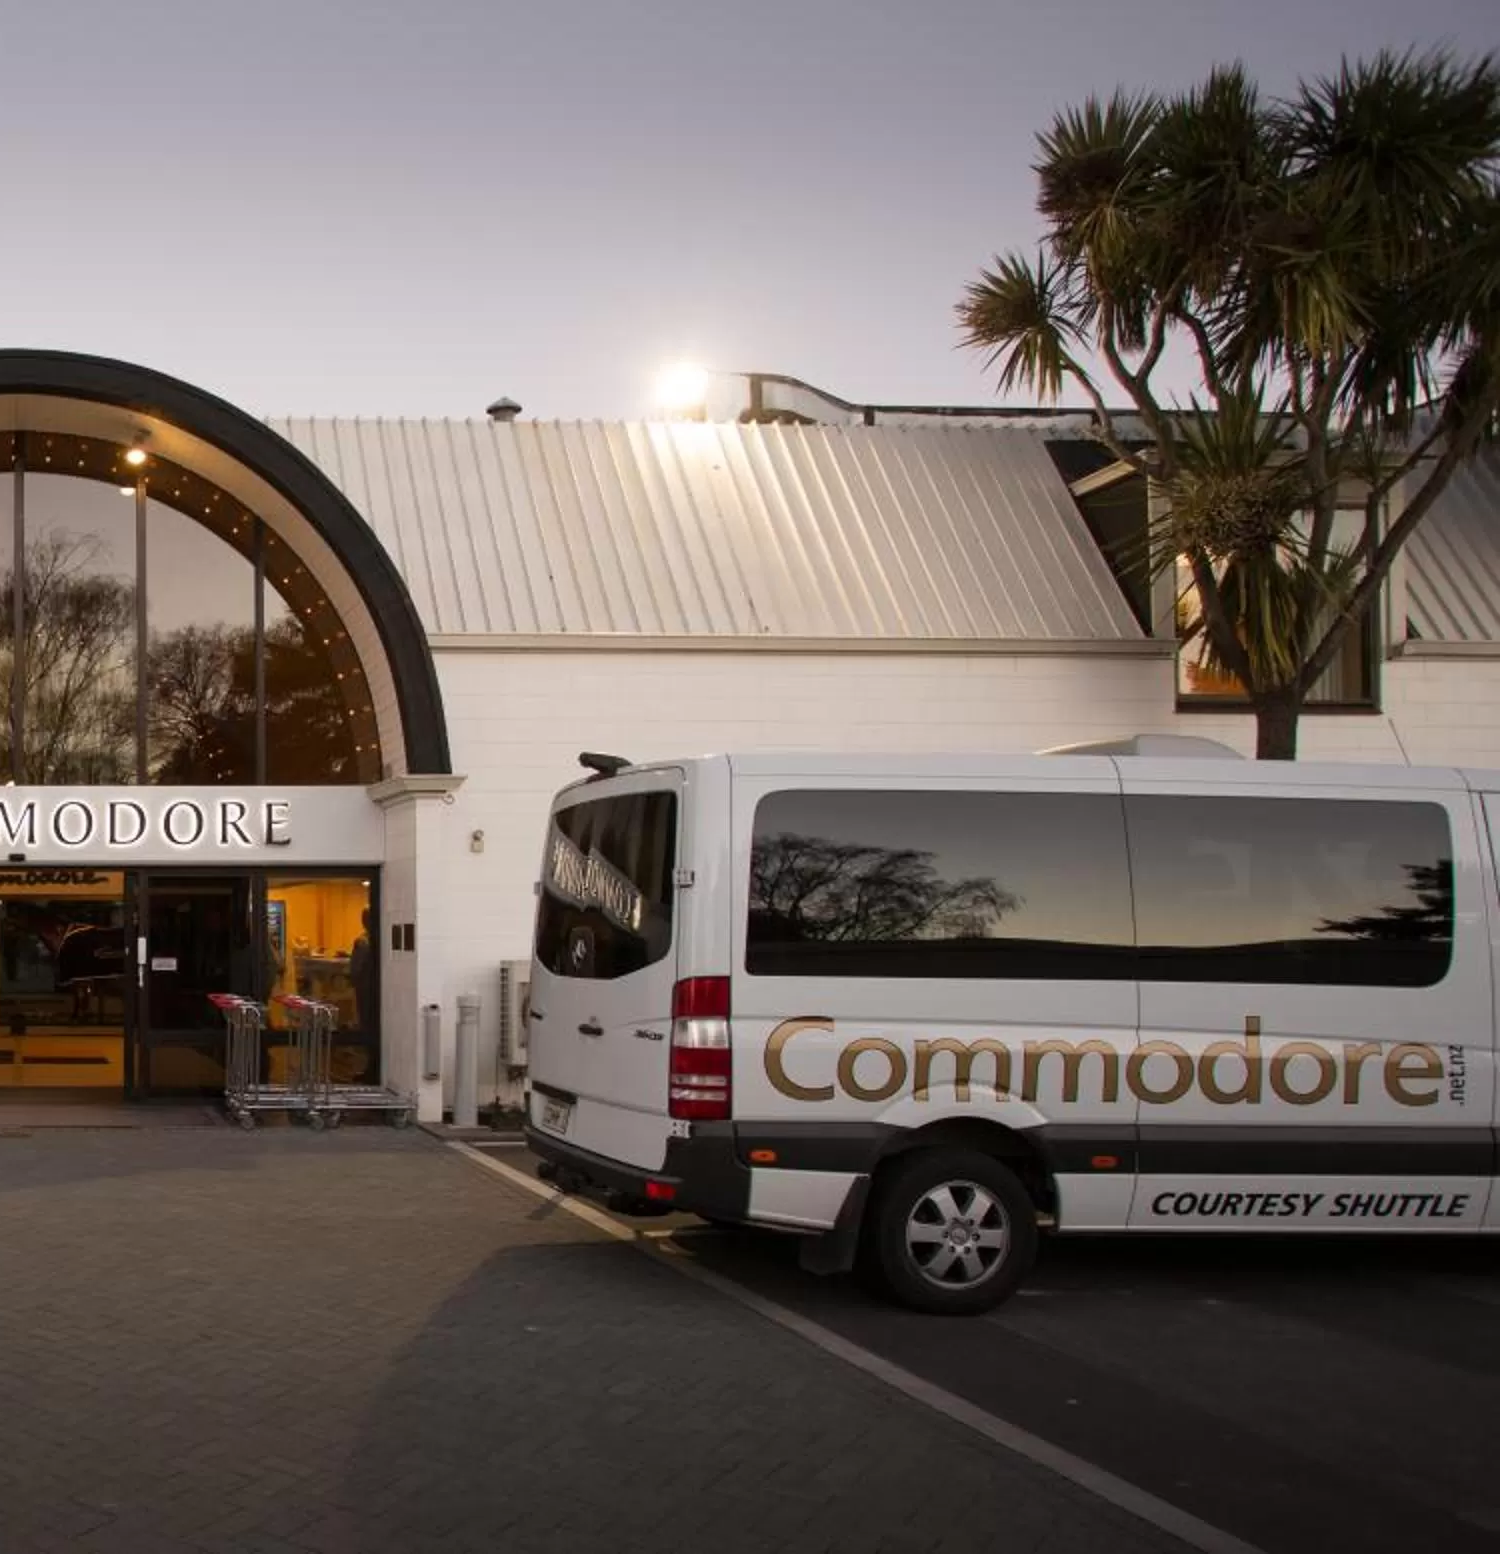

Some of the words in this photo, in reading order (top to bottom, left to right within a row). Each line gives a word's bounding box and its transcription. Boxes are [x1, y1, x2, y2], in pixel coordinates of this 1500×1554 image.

[764, 1015, 1444, 1106] Commodore
[1447, 1044, 1465, 1107] .net.nz
[1151, 1191, 1324, 1217] COURTESY
[1328, 1193, 1470, 1217] SHUTTLE
